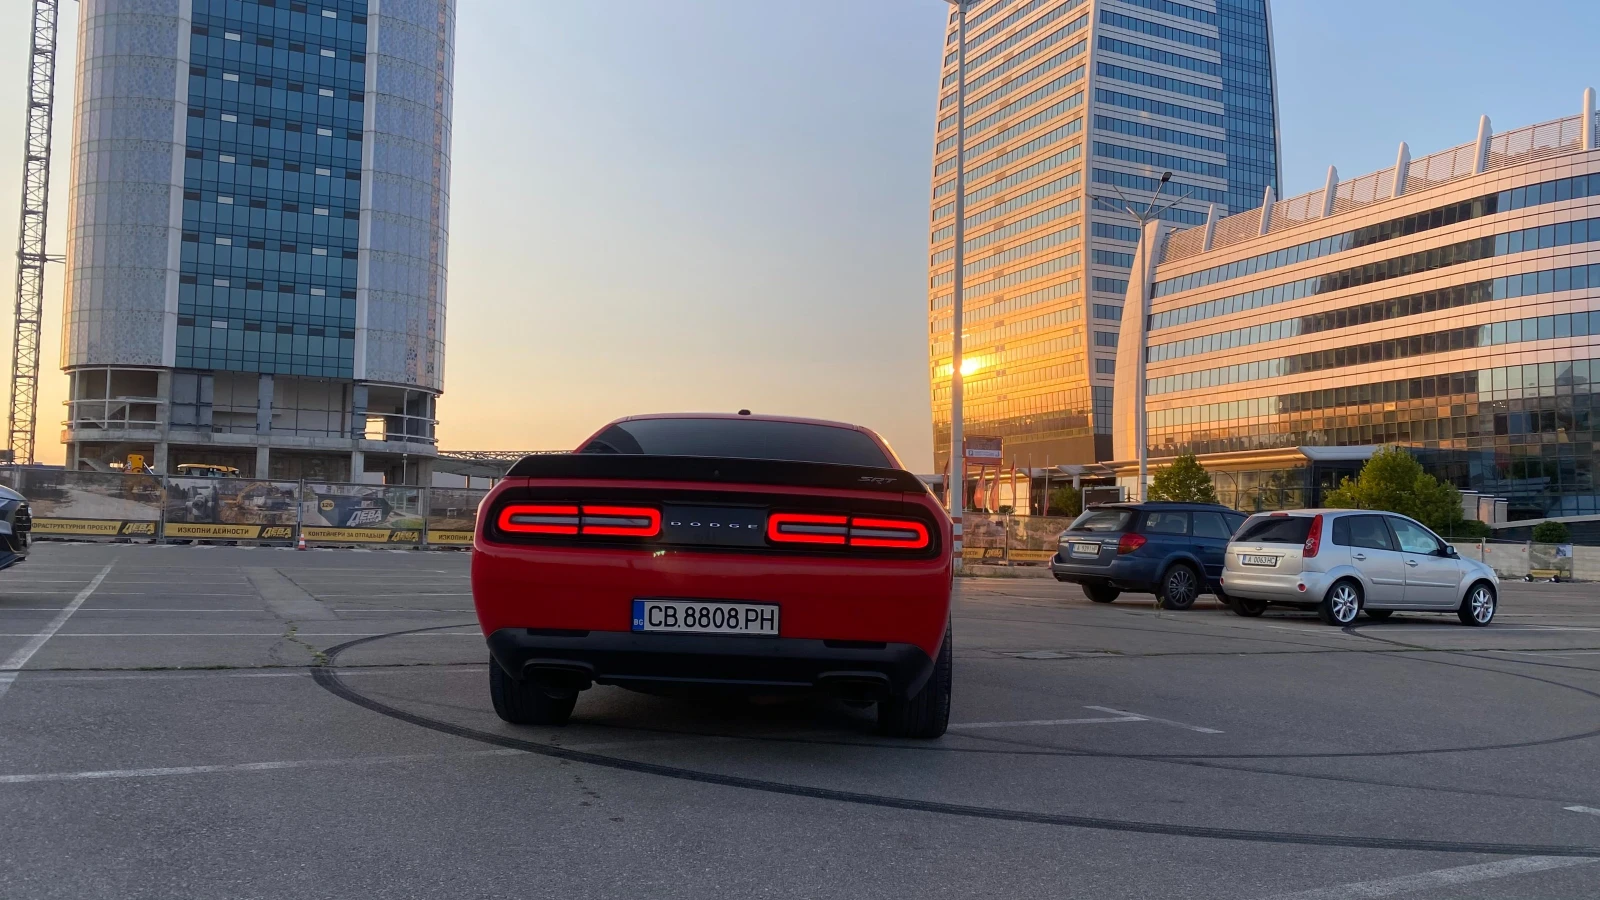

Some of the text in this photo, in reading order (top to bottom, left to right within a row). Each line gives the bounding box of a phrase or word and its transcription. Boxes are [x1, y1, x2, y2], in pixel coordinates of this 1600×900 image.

[858, 476, 898, 485] SRT
[346, 508, 383, 527] ДЕВА
[32, 522, 86, 530] ФРАСТРУКТУРНИ
[670, 521, 758, 529] DODGE
[212, 527, 249, 535] ДЕЙНОСТИ
[633, 618, 644, 626] BG
